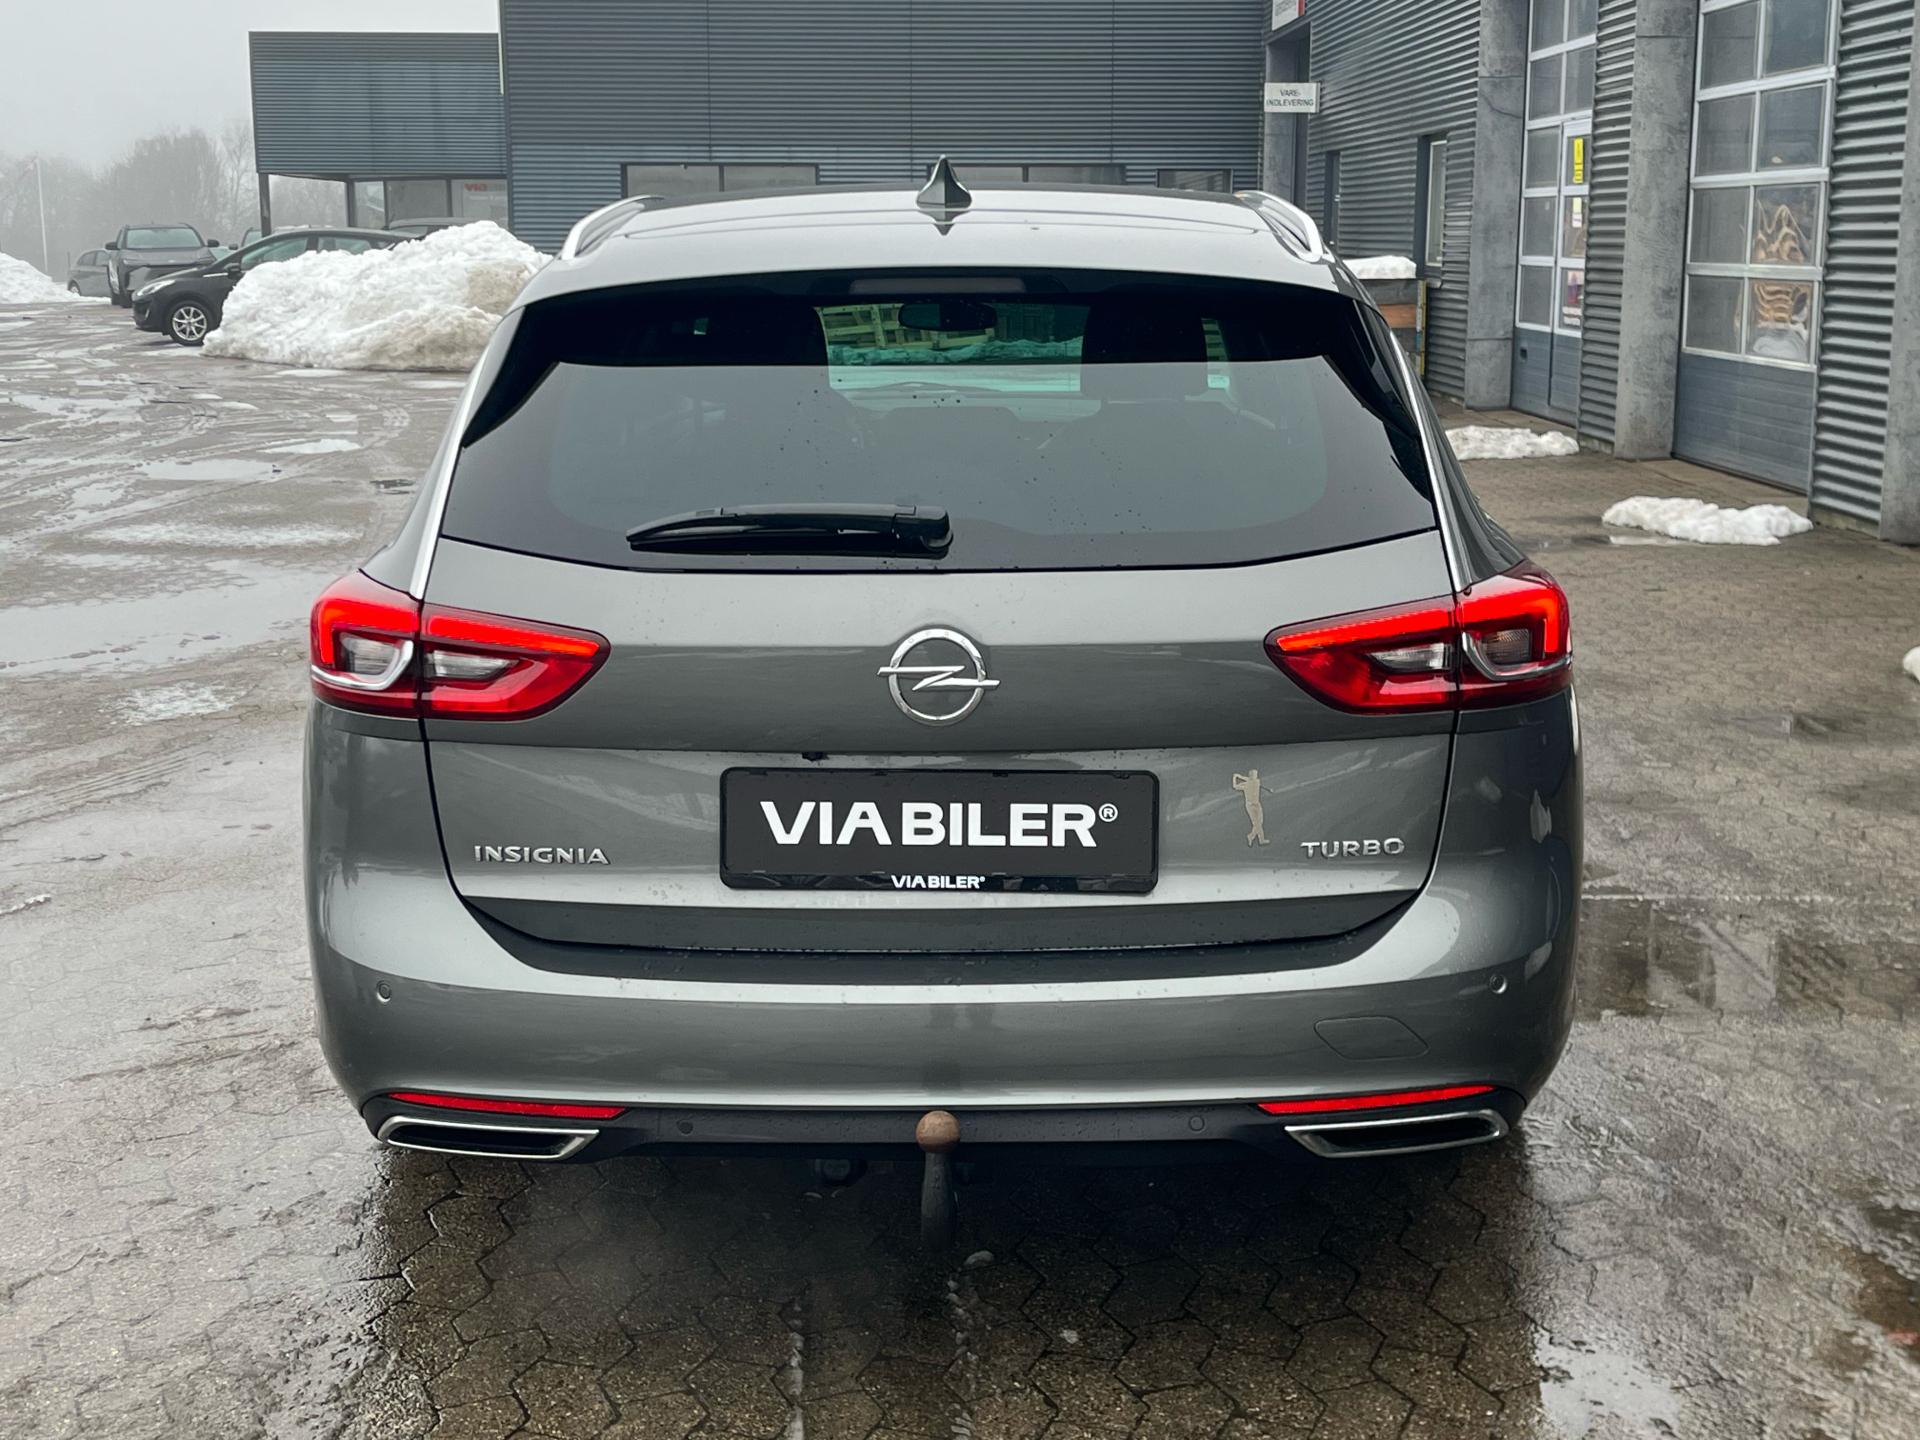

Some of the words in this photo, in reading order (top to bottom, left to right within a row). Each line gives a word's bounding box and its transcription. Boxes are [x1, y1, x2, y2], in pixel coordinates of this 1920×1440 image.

[1280, 89, 1301, 97] VARE-
[1266, 99, 1314, 107] INDLEVERING
[760, 801, 892, 845] VIA
[474, 845, 610, 865] INSIGNIA
[1300, 837, 1405, 858] TURBO
[890, 874, 927, 889] VIA
